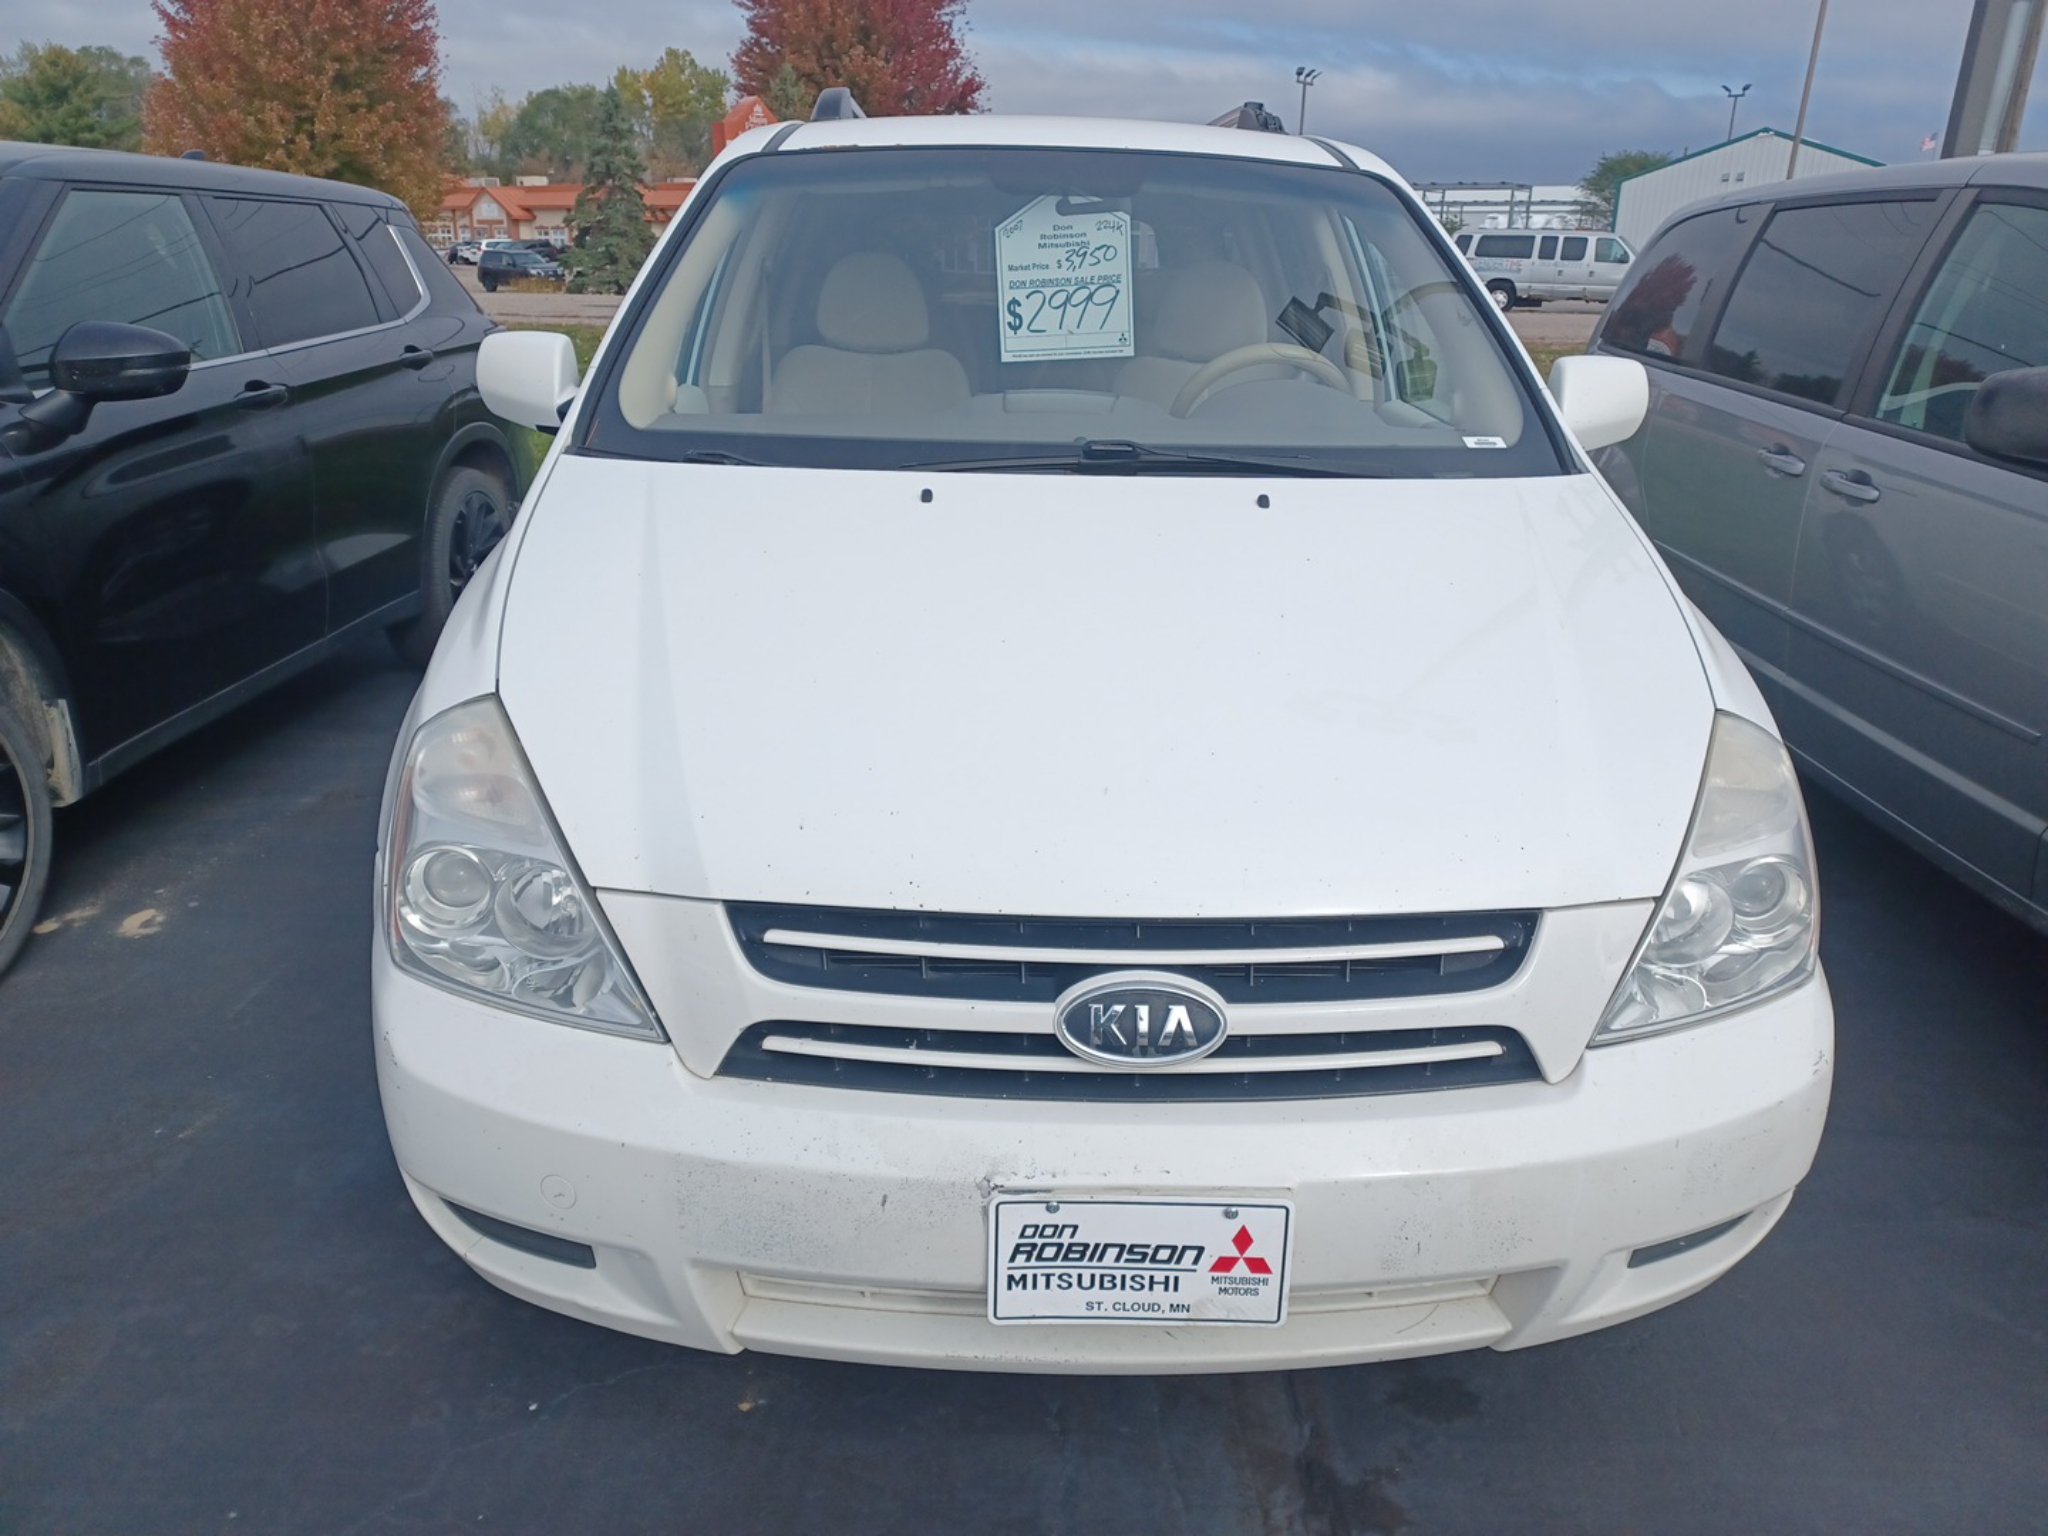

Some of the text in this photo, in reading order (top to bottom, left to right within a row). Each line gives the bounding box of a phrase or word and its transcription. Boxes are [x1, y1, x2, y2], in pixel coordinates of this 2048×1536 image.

[1040, 231, 1087, 240] Robinson
[1038, 240, 1090, 249] Mitsubishi
[1008, 263, 1031, 272] Market
[1032, 262, 1049, 271] Price
[1009, 274, 1122, 289] DON ROBINSON SALE PRICE
[1088, 1004, 1198, 1047] KIA
[1018, 1224, 1079, 1239] DON
[1008, 1242, 1205, 1266] ROBINSON
[1006, 1273, 1180, 1293] MITSUBISHI
[1210, 1276, 1269, 1286] MITSUBISHI
[1218, 1286, 1260, 1297] MOTORS
[1085, 1301, 1191, 1314] ST. CLOUD, MN
